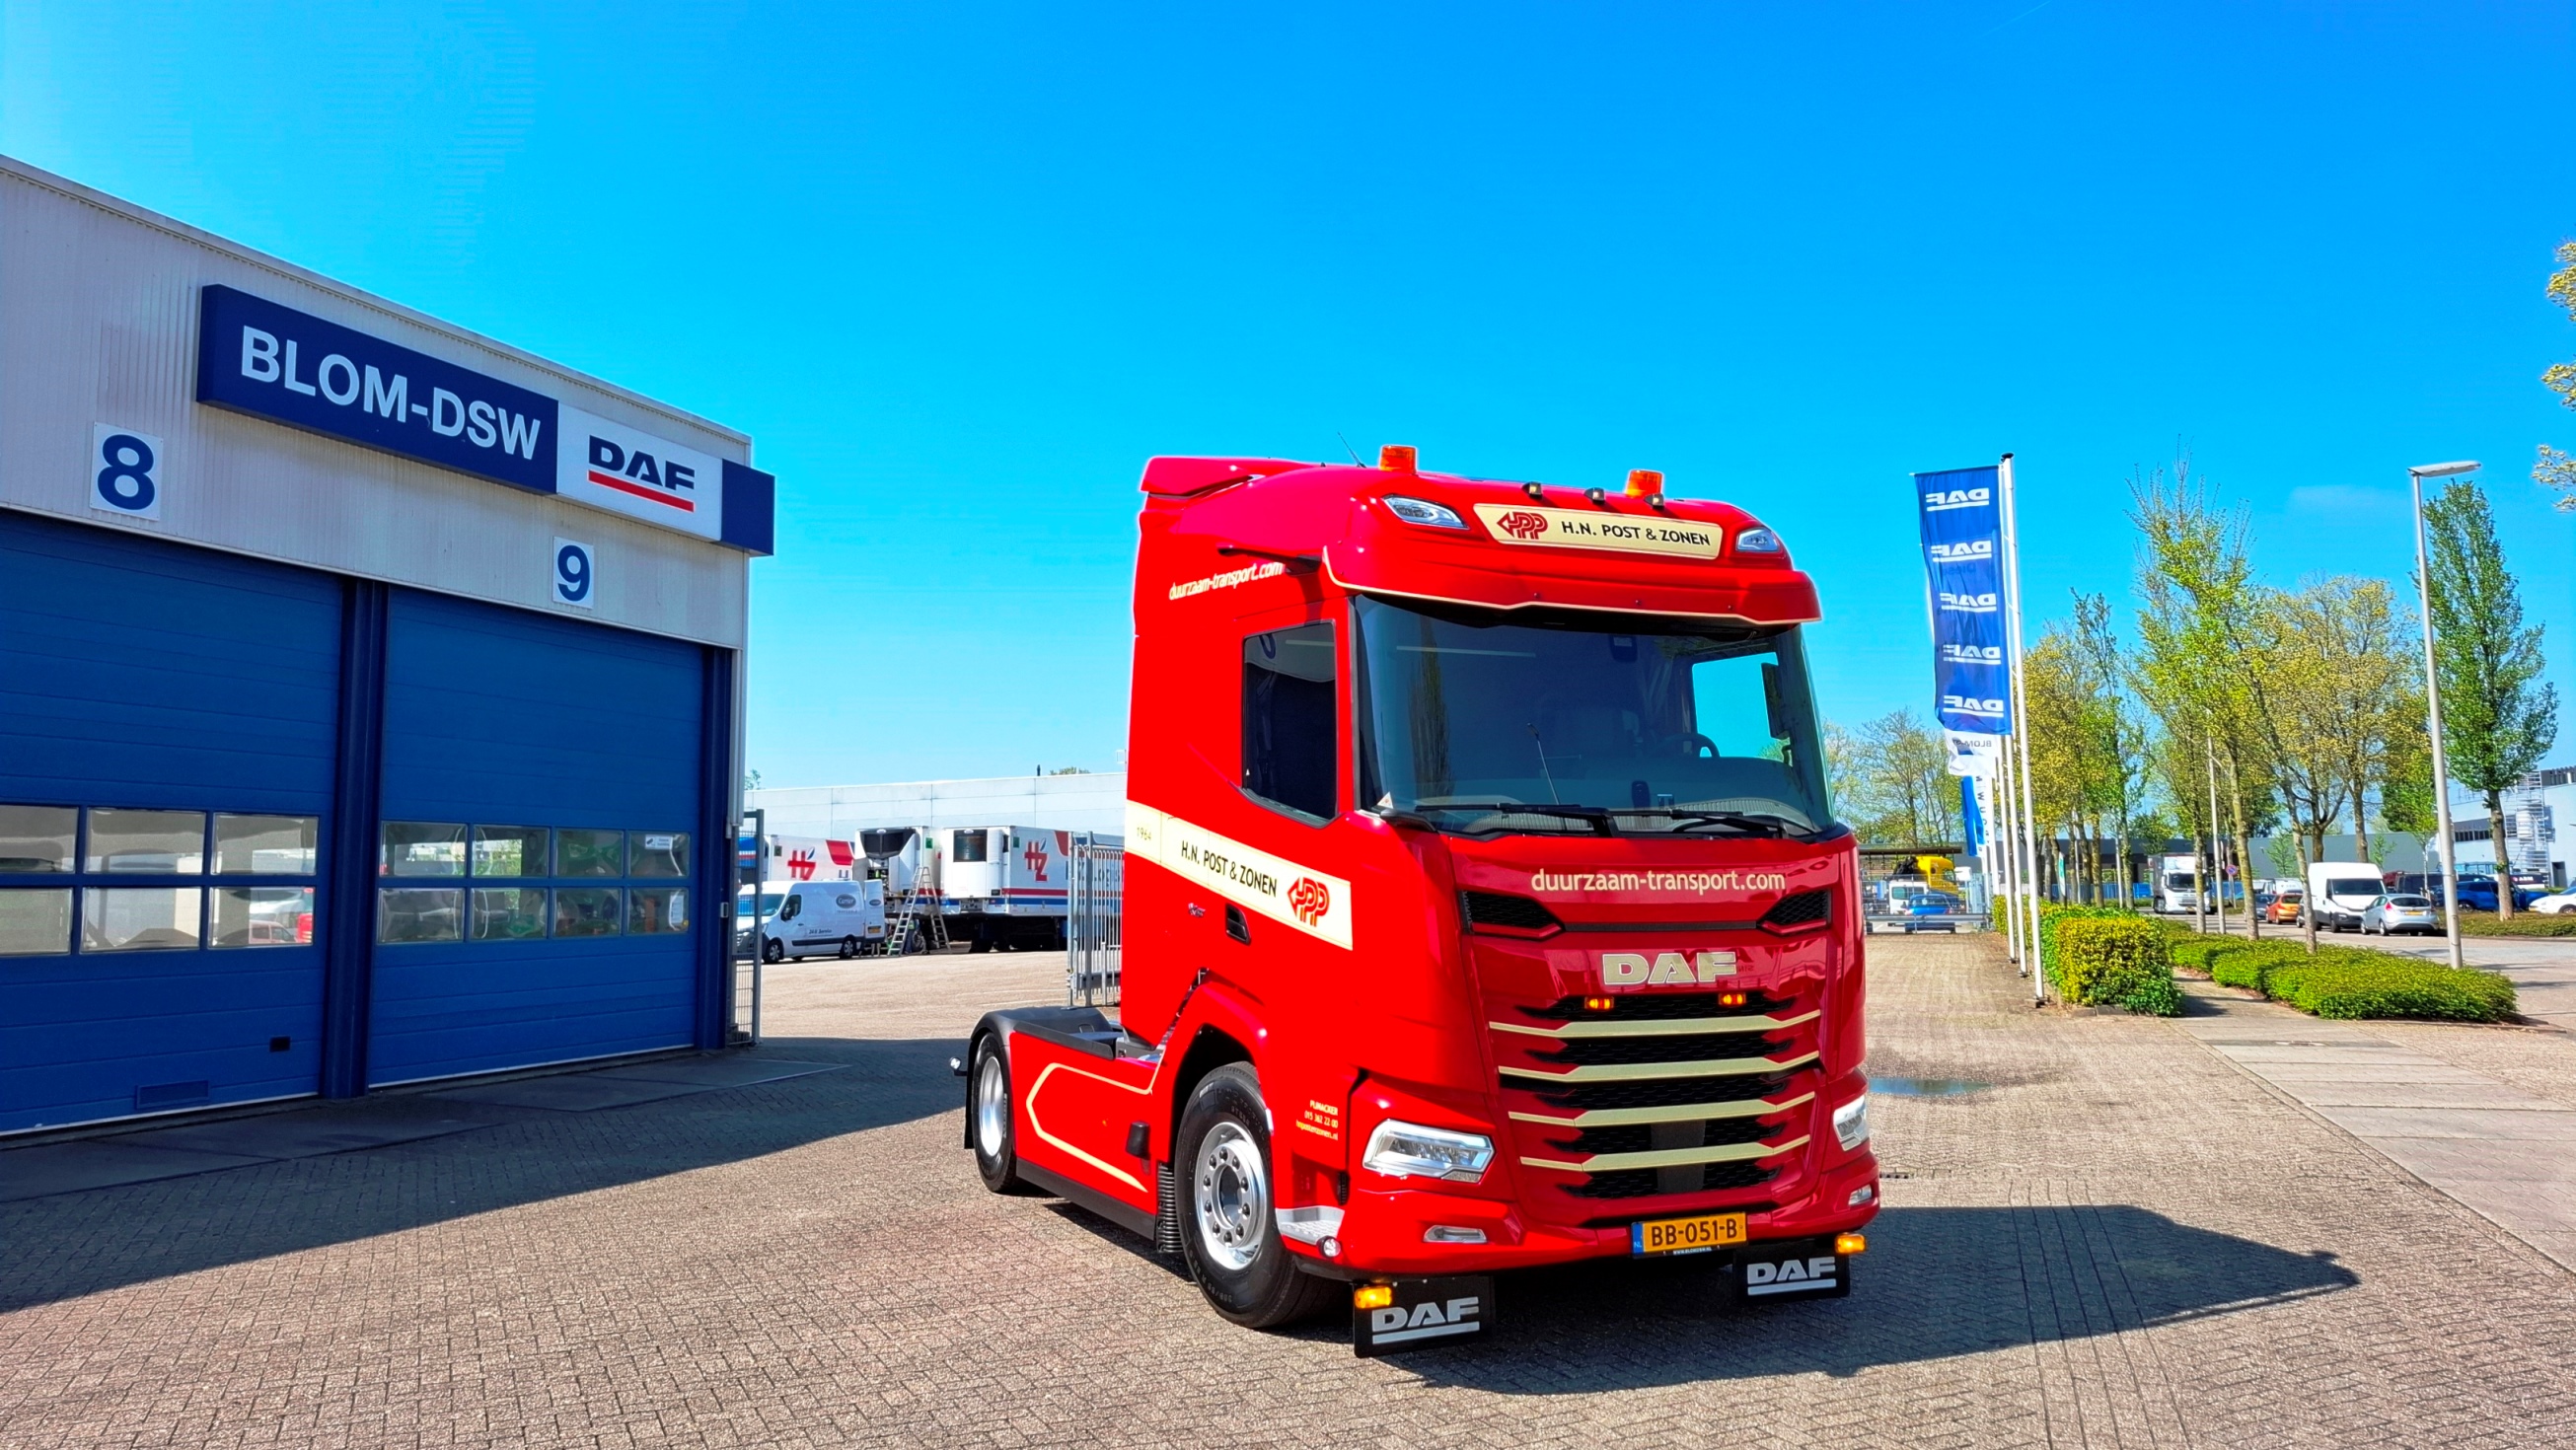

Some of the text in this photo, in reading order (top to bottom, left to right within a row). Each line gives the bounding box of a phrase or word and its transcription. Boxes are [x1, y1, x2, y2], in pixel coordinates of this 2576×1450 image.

[242, 326, 540, 461] BLOM-DSW
[98, 434, 155, 511] 8
[589, 435, 695, 491] DAF
[1562, 521, 1711, 546] H.N. POST & ZONEN
[556, 544, 591, 602] 9
[1169, 561, 1286, 600] duurzaam-transport.com
[1181, 840, 1277, 898] H.N. POST & ZONEN
[1531, 869, 1786, 896] duurzaam-transport.com
[1602, 951, 1737, 985] DAF
[1651, 1218, 1737, 1247] BB-051-B
[1747, 1257, 1836, 1285] DAF
[1372, 1296, 1479, 1333] DAF
